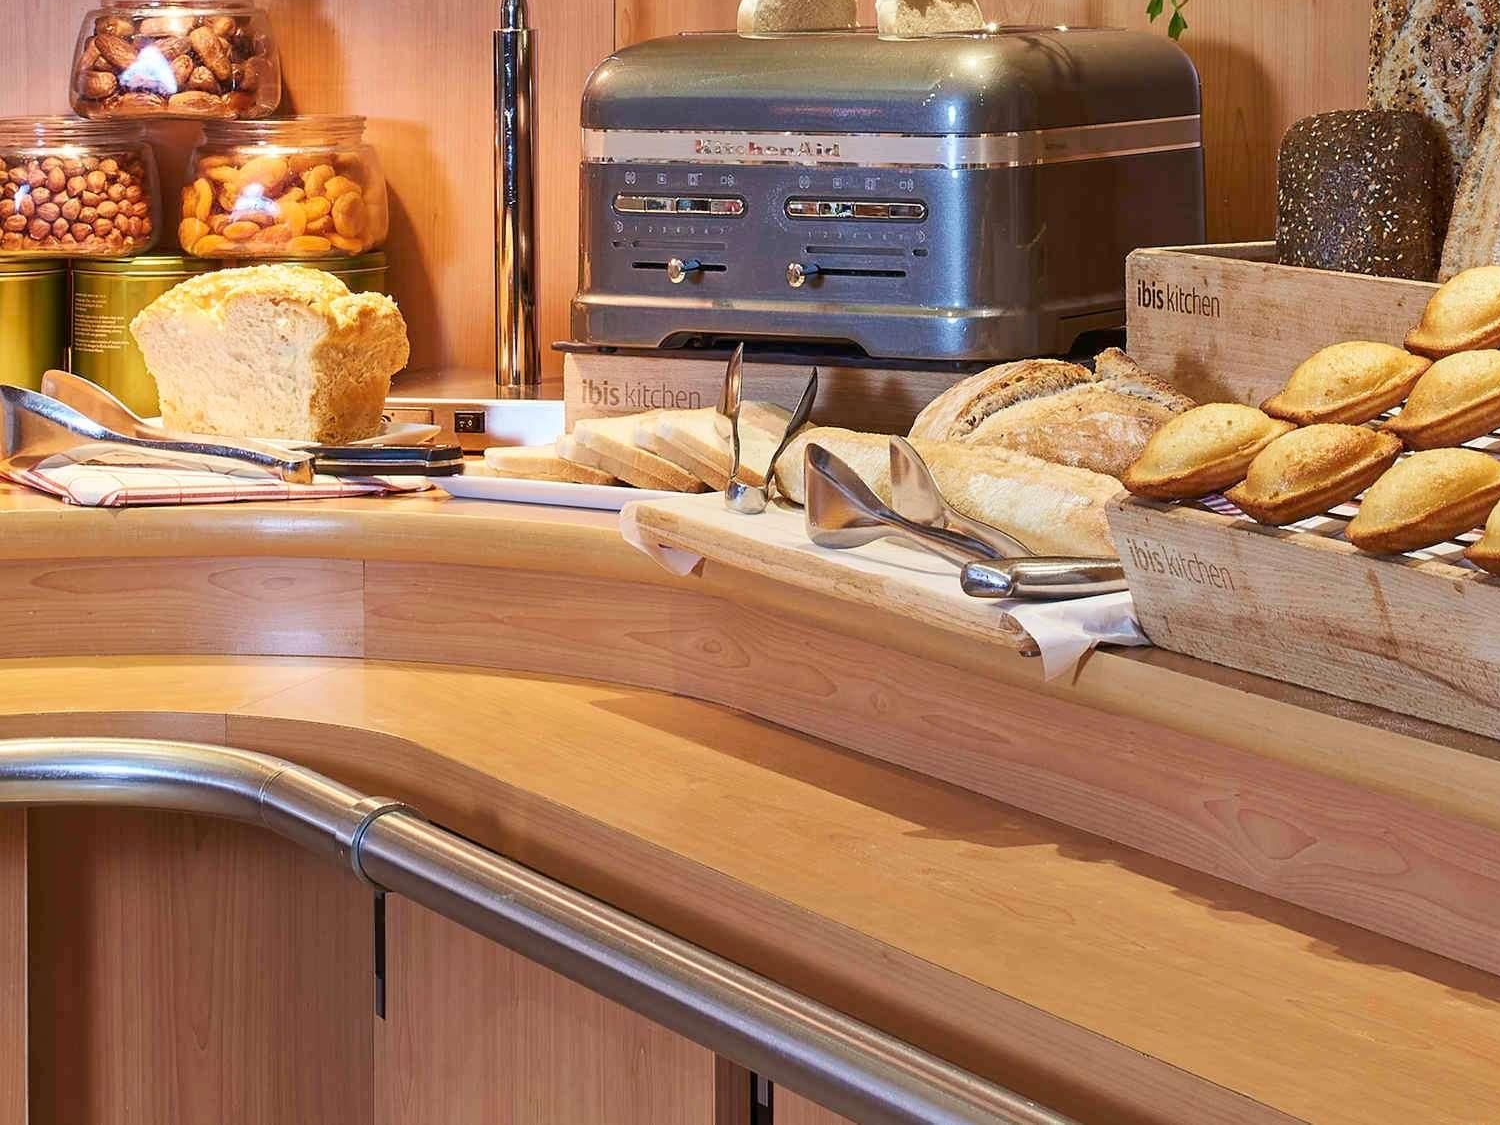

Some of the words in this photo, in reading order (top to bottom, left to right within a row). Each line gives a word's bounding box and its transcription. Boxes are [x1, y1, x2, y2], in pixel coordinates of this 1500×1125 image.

[1137, 279, 1164, 310] ibis
[1166, 282, 1221, 318] kitchen
[581, 378, 620, 406] ibis
[625, 380, 701, 410] kitchen
[1126, 538, 1165, 574] ibis
[1161, 545, 1236, 591] kitchen
